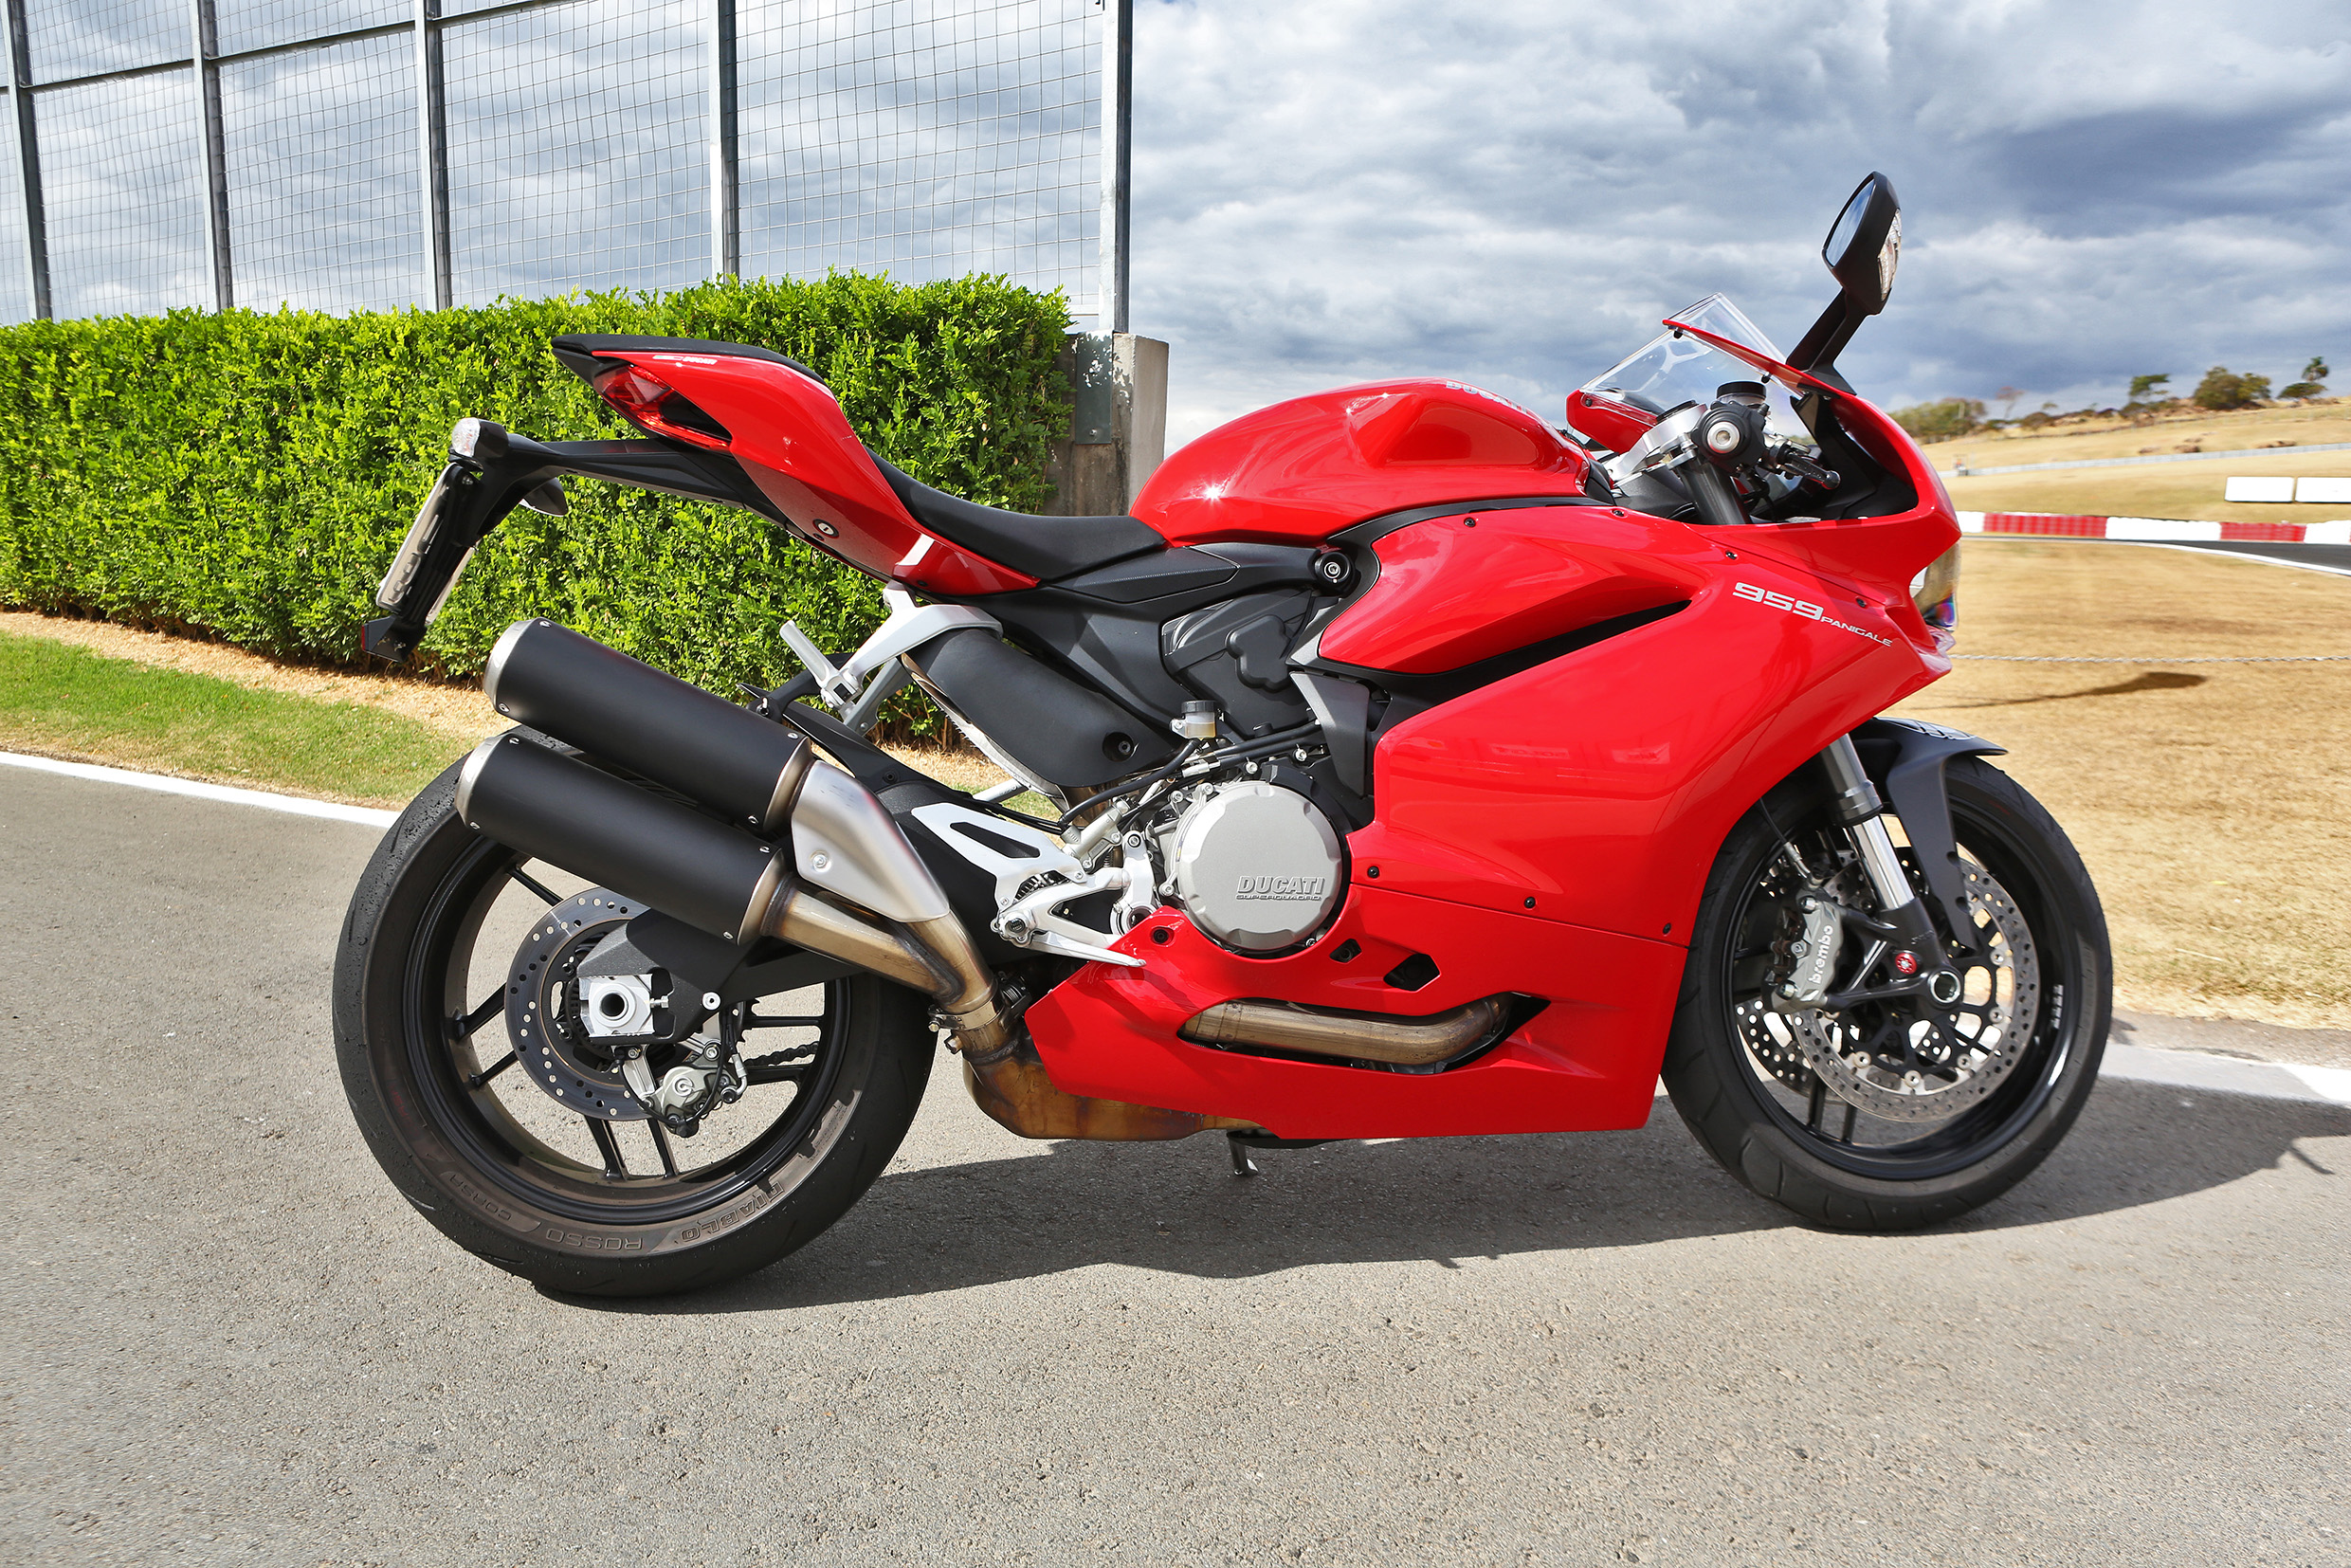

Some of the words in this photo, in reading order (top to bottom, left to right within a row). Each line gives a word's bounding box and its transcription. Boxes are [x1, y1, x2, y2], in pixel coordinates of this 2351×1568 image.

[1733, 582, 1824, 620] 959
[1820, 616, 1893, 647] PANIGALE
[1237, 875, 1325, 894] DUCATI
[1808, 924, 1834, 984] brembo
[448, 1175, 512, 1221] CORSA
[545, 1229, 644, 1251] ROSSO
